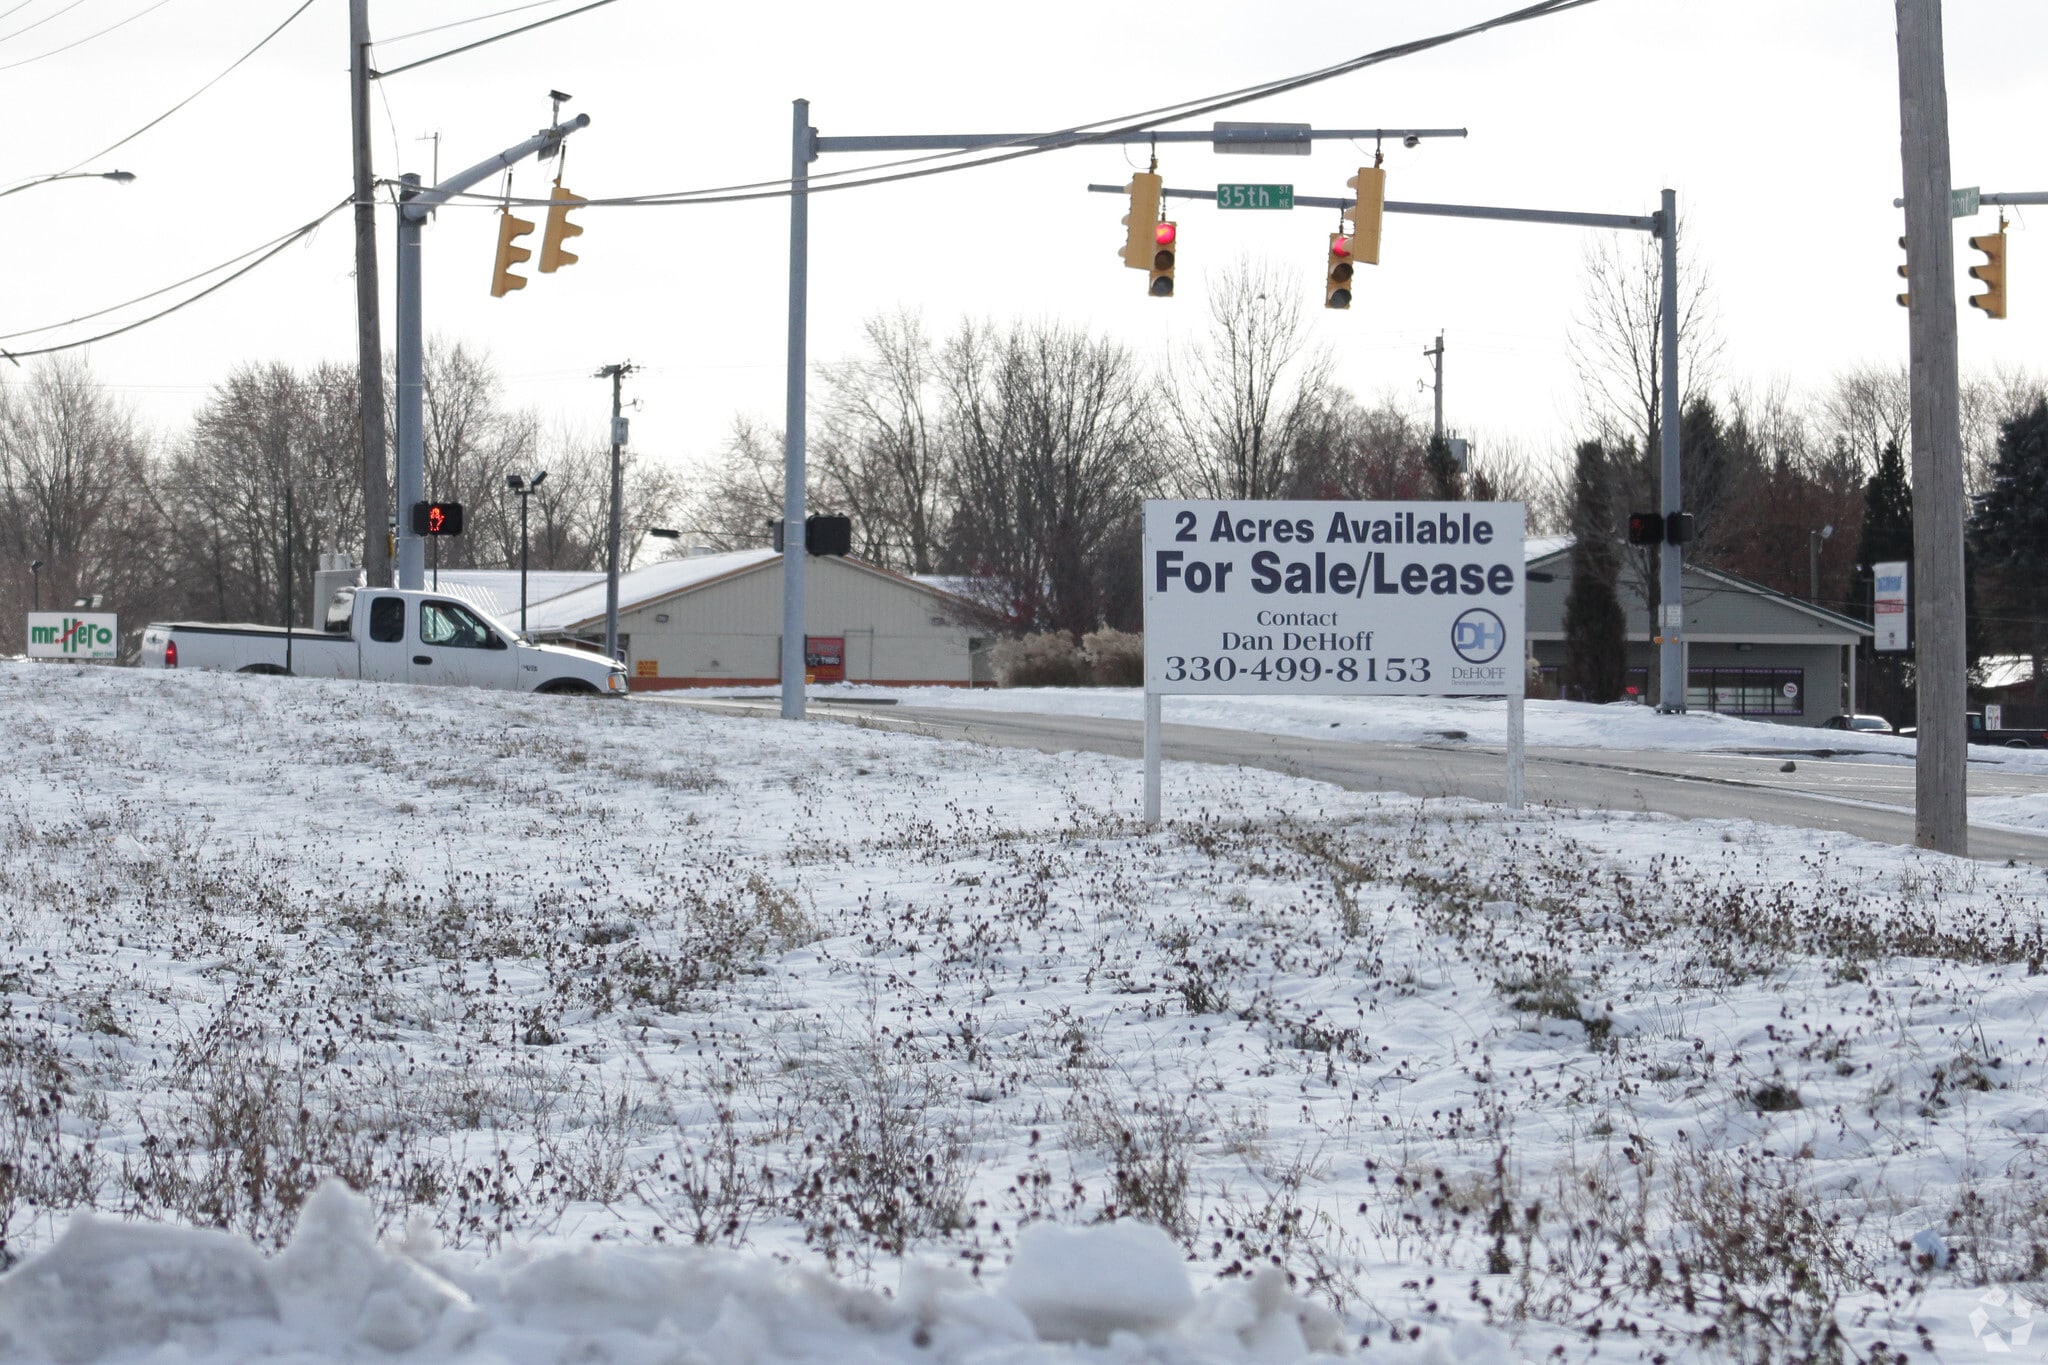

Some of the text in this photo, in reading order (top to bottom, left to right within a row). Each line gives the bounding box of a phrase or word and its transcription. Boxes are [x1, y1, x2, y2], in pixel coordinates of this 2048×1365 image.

[1220, 186, 1269, 207] 35th
[1279, 199, 1289, 208] NE
[1175, 510, 1493, 545] 2 Acres Available
[1156, 550, 1514, 599] For Sale/Lease
[1256, 610, 1338, 626] Contact
[61, 618, 113, 653] Hero
[1222, 631, 1375, 651] Dan DeHoff
[1457, 622, 1501, 649] DH
[1165, 656, 1432, 682] 330-499-8153
